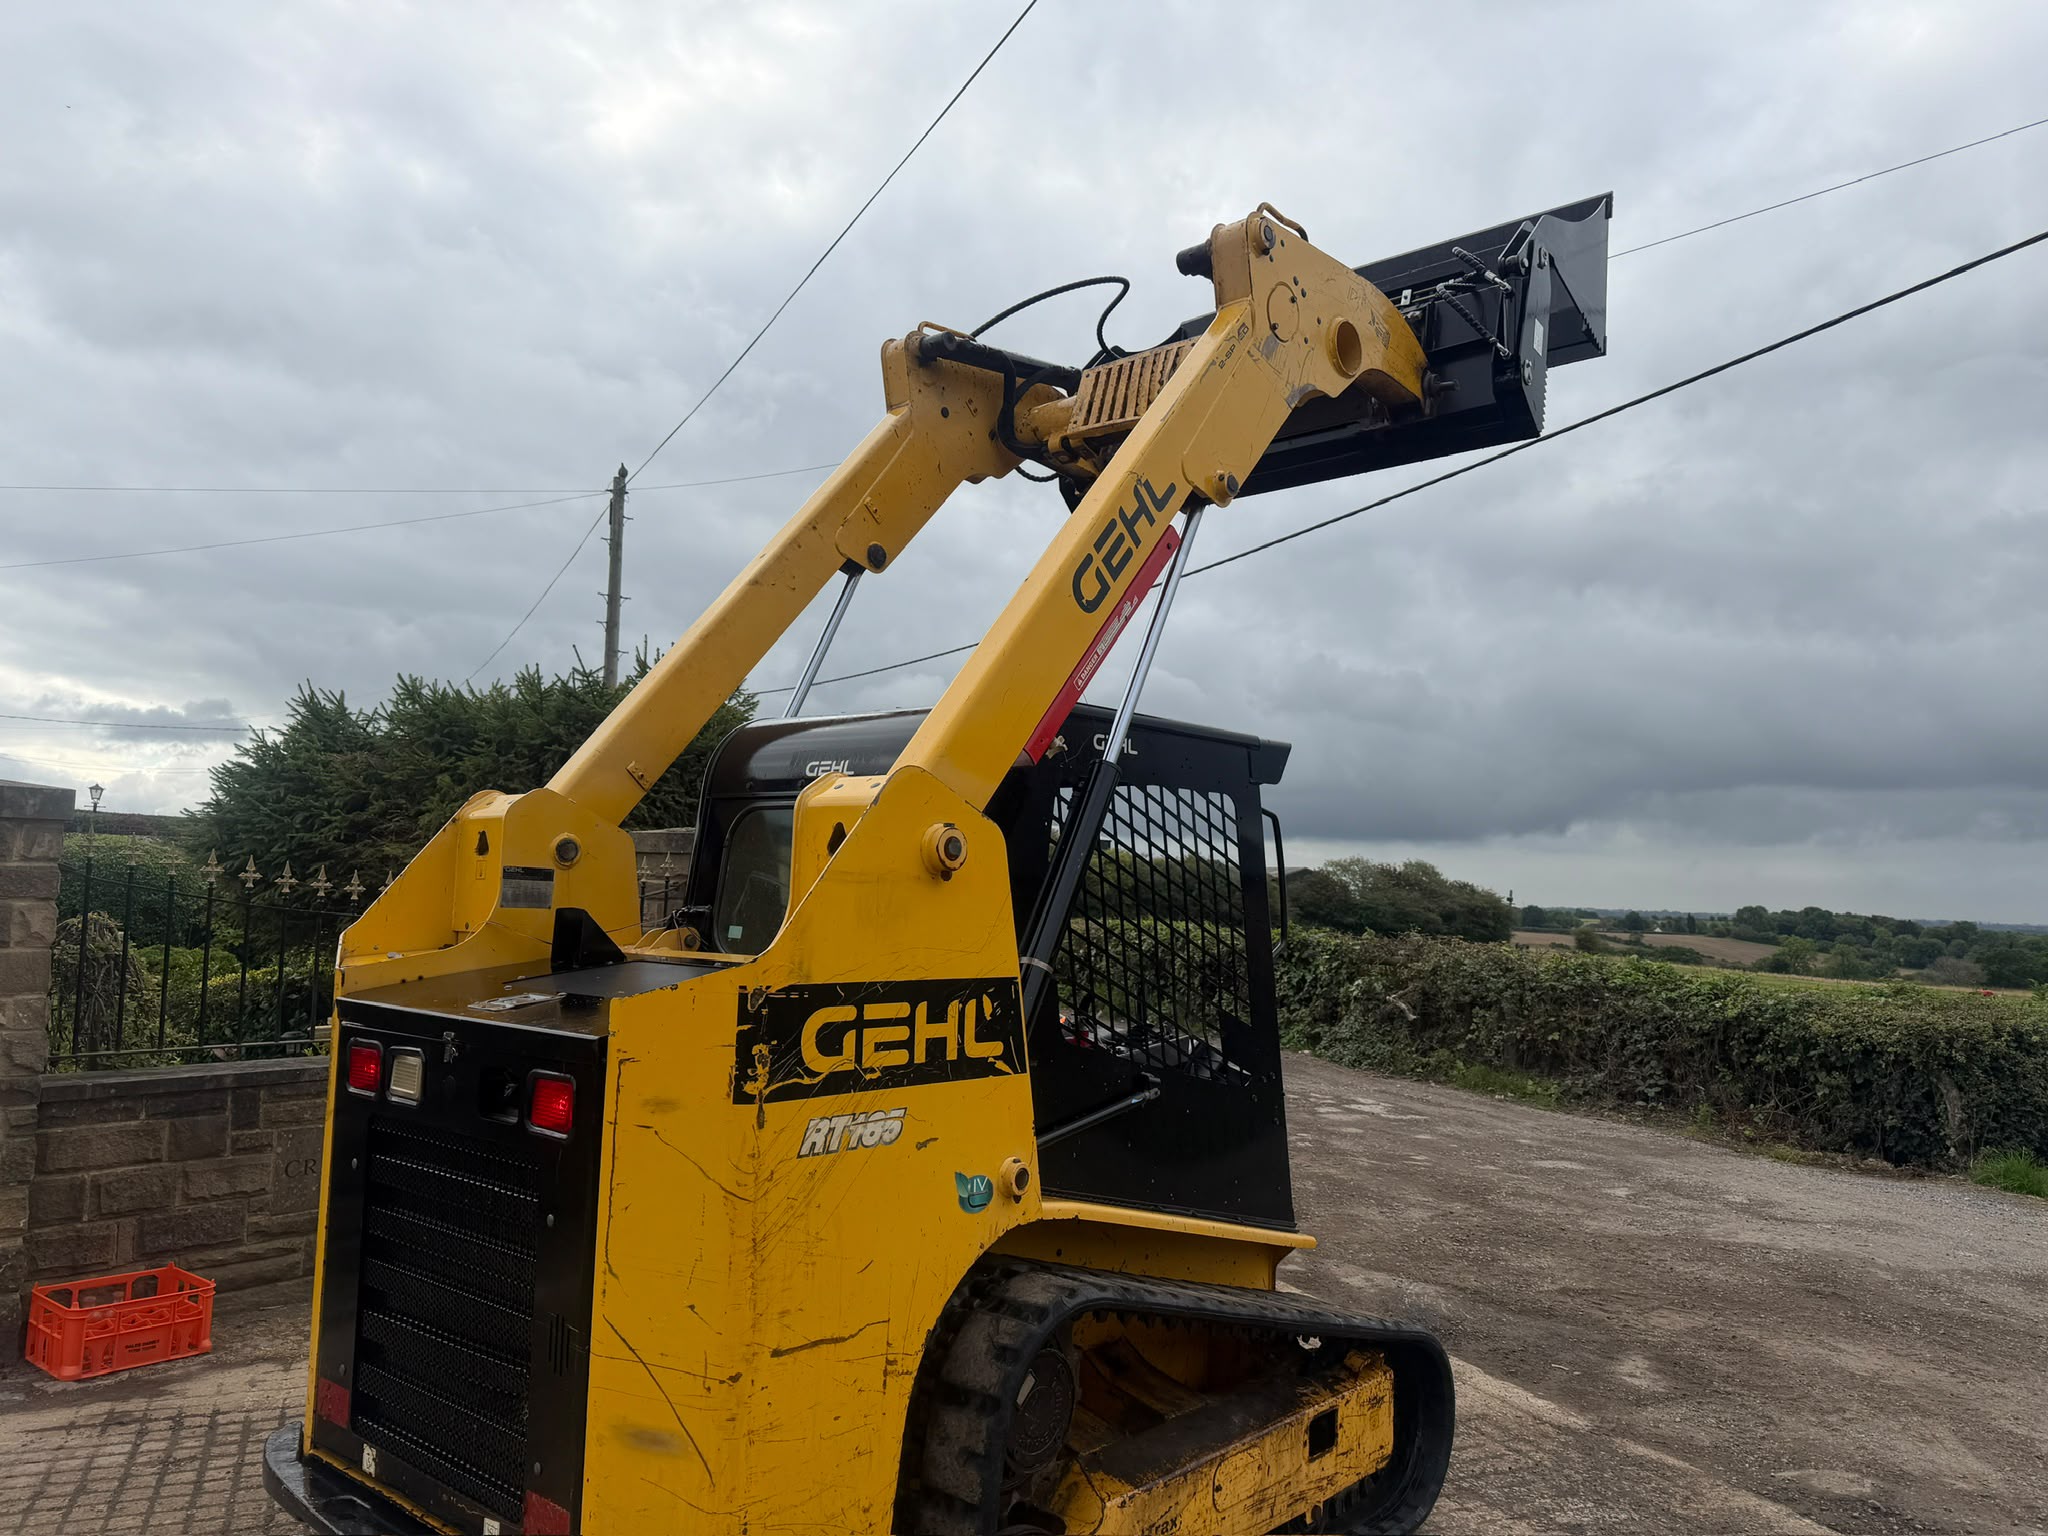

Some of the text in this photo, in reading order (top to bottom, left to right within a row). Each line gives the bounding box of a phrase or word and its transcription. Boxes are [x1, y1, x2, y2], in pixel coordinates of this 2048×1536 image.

[1218, 322, 1249, 369] 2-SPED
[1072, 479, 1177, 613] GEHL
[805, 760, 854, 776] GEHL
[801, 998, 1004, 1073] GEHL
